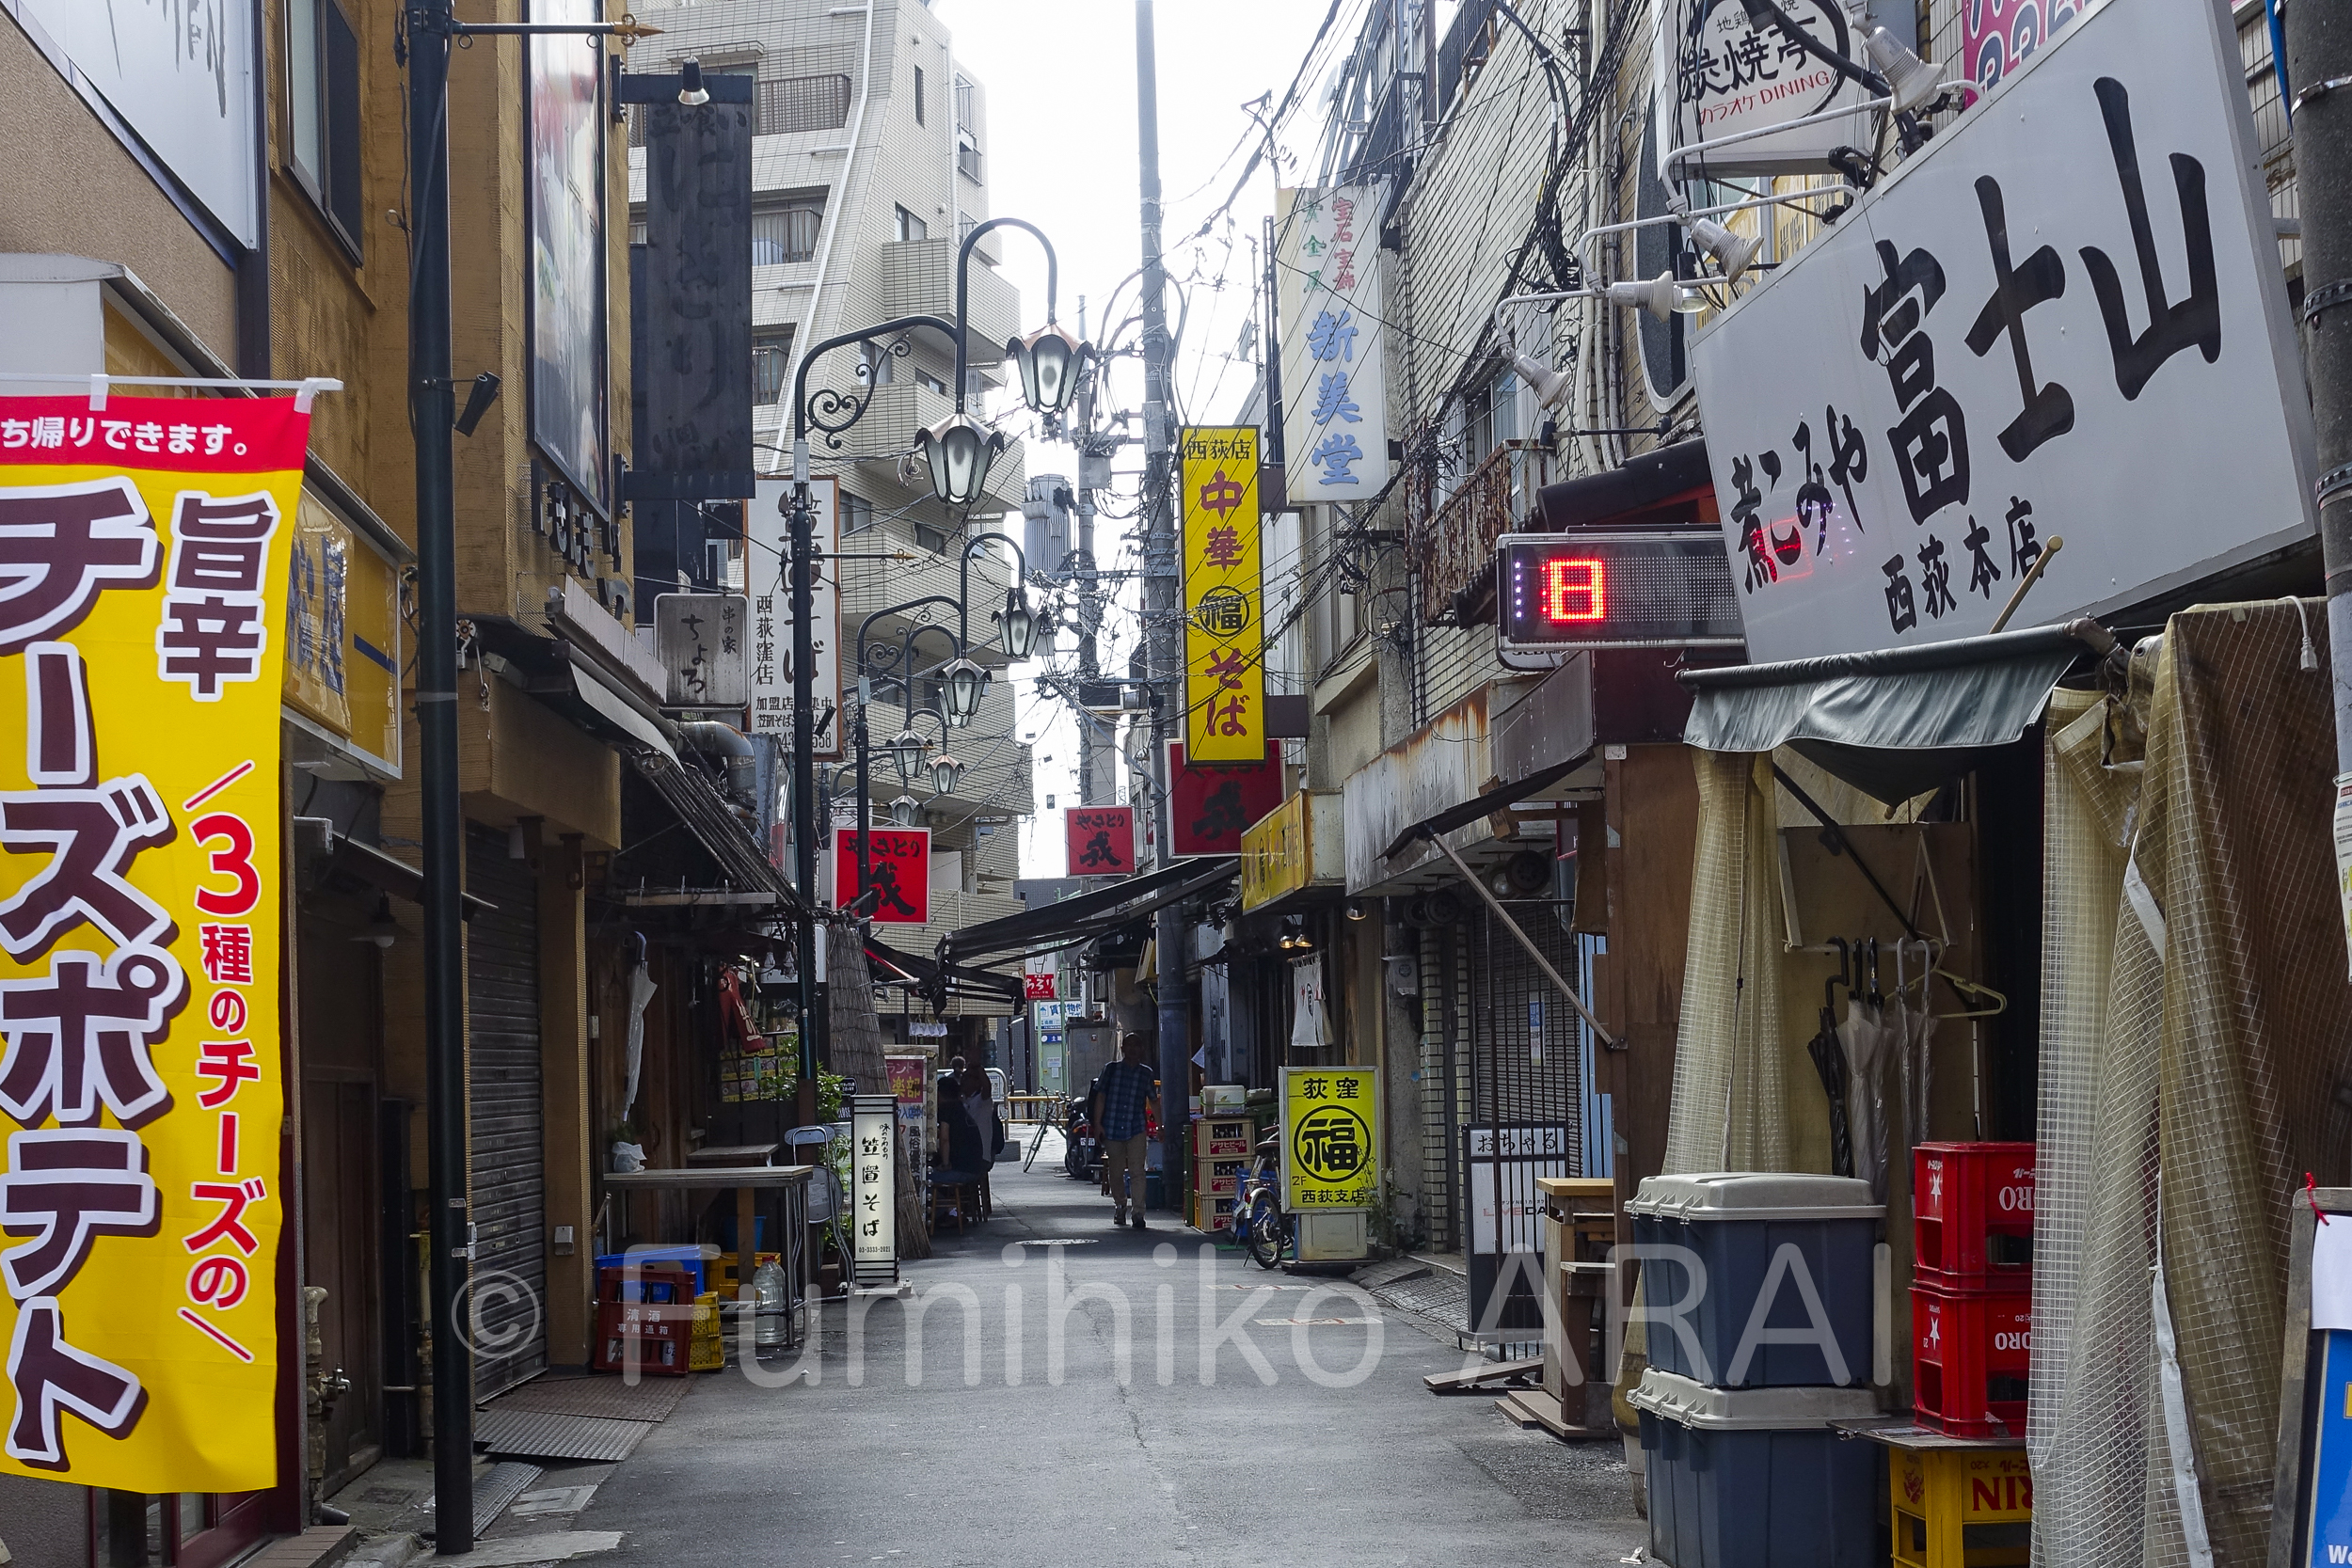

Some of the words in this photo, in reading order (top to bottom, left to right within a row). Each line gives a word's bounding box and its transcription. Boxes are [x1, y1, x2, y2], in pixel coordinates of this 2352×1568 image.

[1700, 95, 1756, 125] カラオケ
[1759, 71, 1831, 104] DINING
[1860, 77, 2222, 526] 富士山
[1306, 309, 1364, 485] 新美堂
[1187, 438, 1252, 461] 西荻店
[159, 490, 280, 702] 旨辛
[1882, 496, 2045, 636] 西荻本店
[680, 613, 708, 694] ちょろ
[722, 605, 738, 655] 串の家
[755, 594, 774, 686] 西荻窪店
[755, 696, 833, 711] 加盟店集中
[0, 477, 190, 1467] チーズポテト
[184, 813, 267, 1311] 3種のチーズの
[1303, 1077, 1359, 1100] 荻窪
[1292, 1176, 1306, 1186] 2F
[1298, 1113, 1364, 1177] 福
[862, 1136, 880, 1237] 笠置そば
[1301, 1189, 1365, 1204] 西荻支店
[627, 1308, 660, 1323] 清酒
